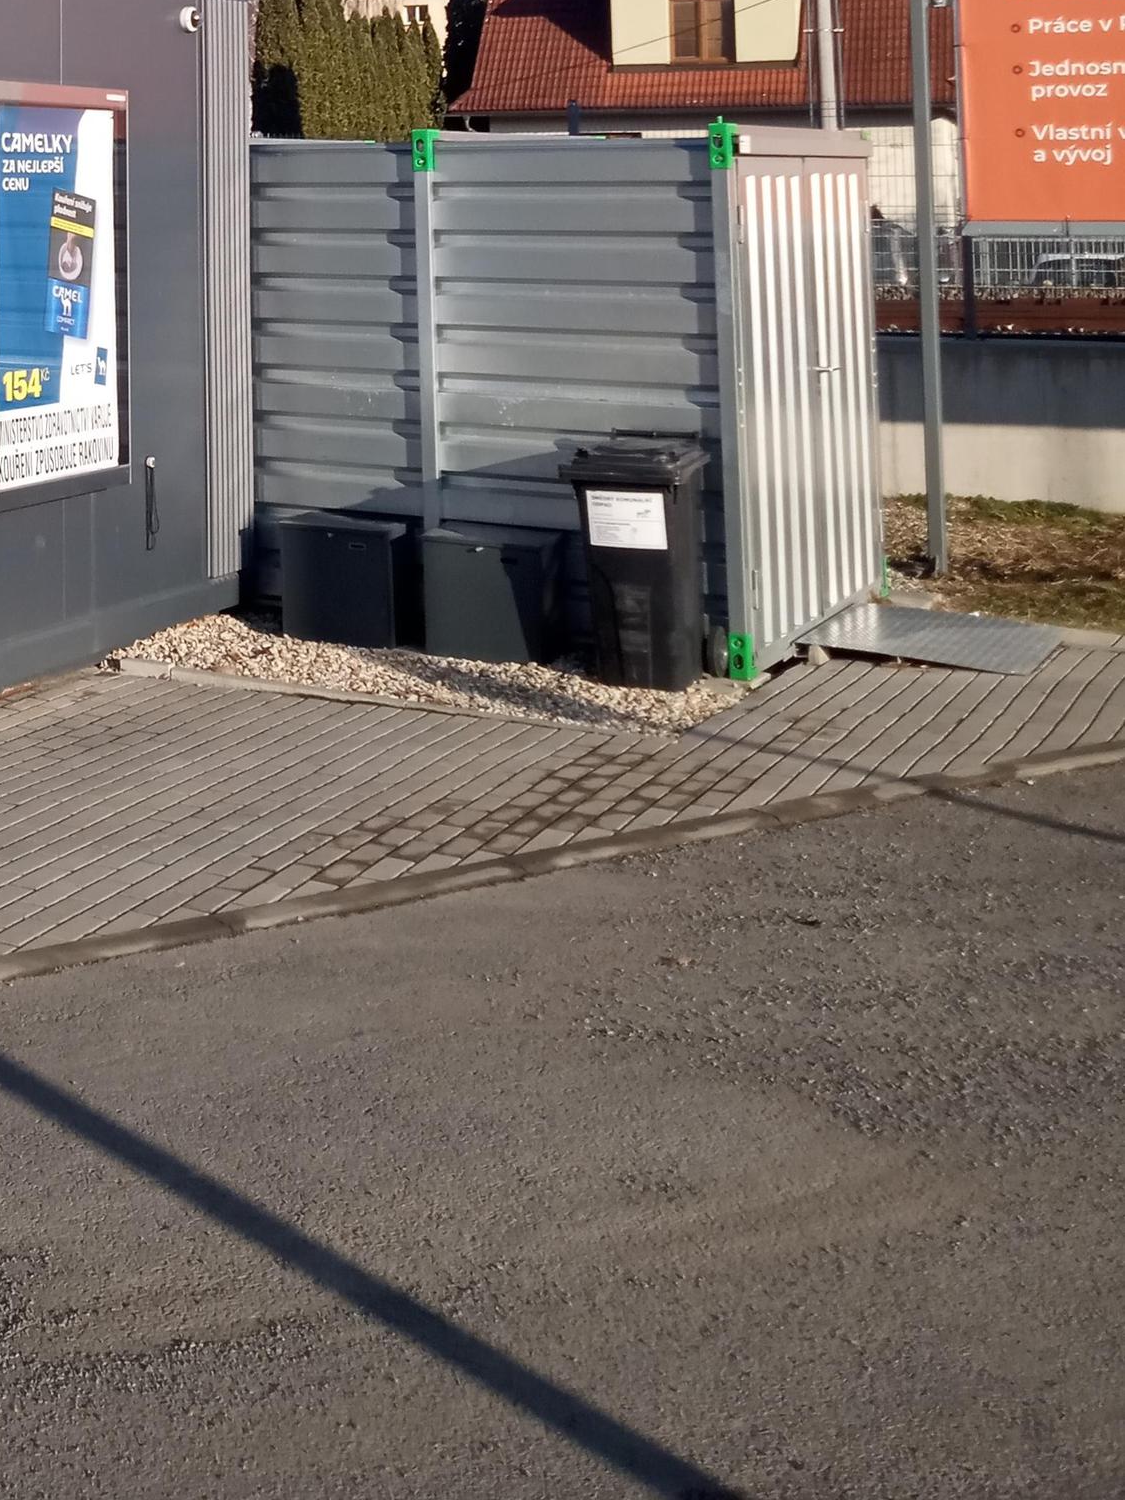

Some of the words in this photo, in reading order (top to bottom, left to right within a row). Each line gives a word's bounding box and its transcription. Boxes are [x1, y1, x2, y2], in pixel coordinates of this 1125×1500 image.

[1028, 17, 1092, 34] Práce
[1098, 19, 1113, 31] v
[1031, 83, 1108, 101] provoz
[1031, 122, 1112, 141] Vlastní
[1, 132, 73, 154] CAMELKY
[1033, 150, 1046, 162] a
[1052, 145, 1112, 165] vývoj
[2, 159, 16, 173] ZA
[17, 156, 64, 174] NEJLEPŠÍ
[2, 178, 29, 191] CENU
[52, 285, 83, 303] CAMEL
[3, 368, 42, 401] 154
